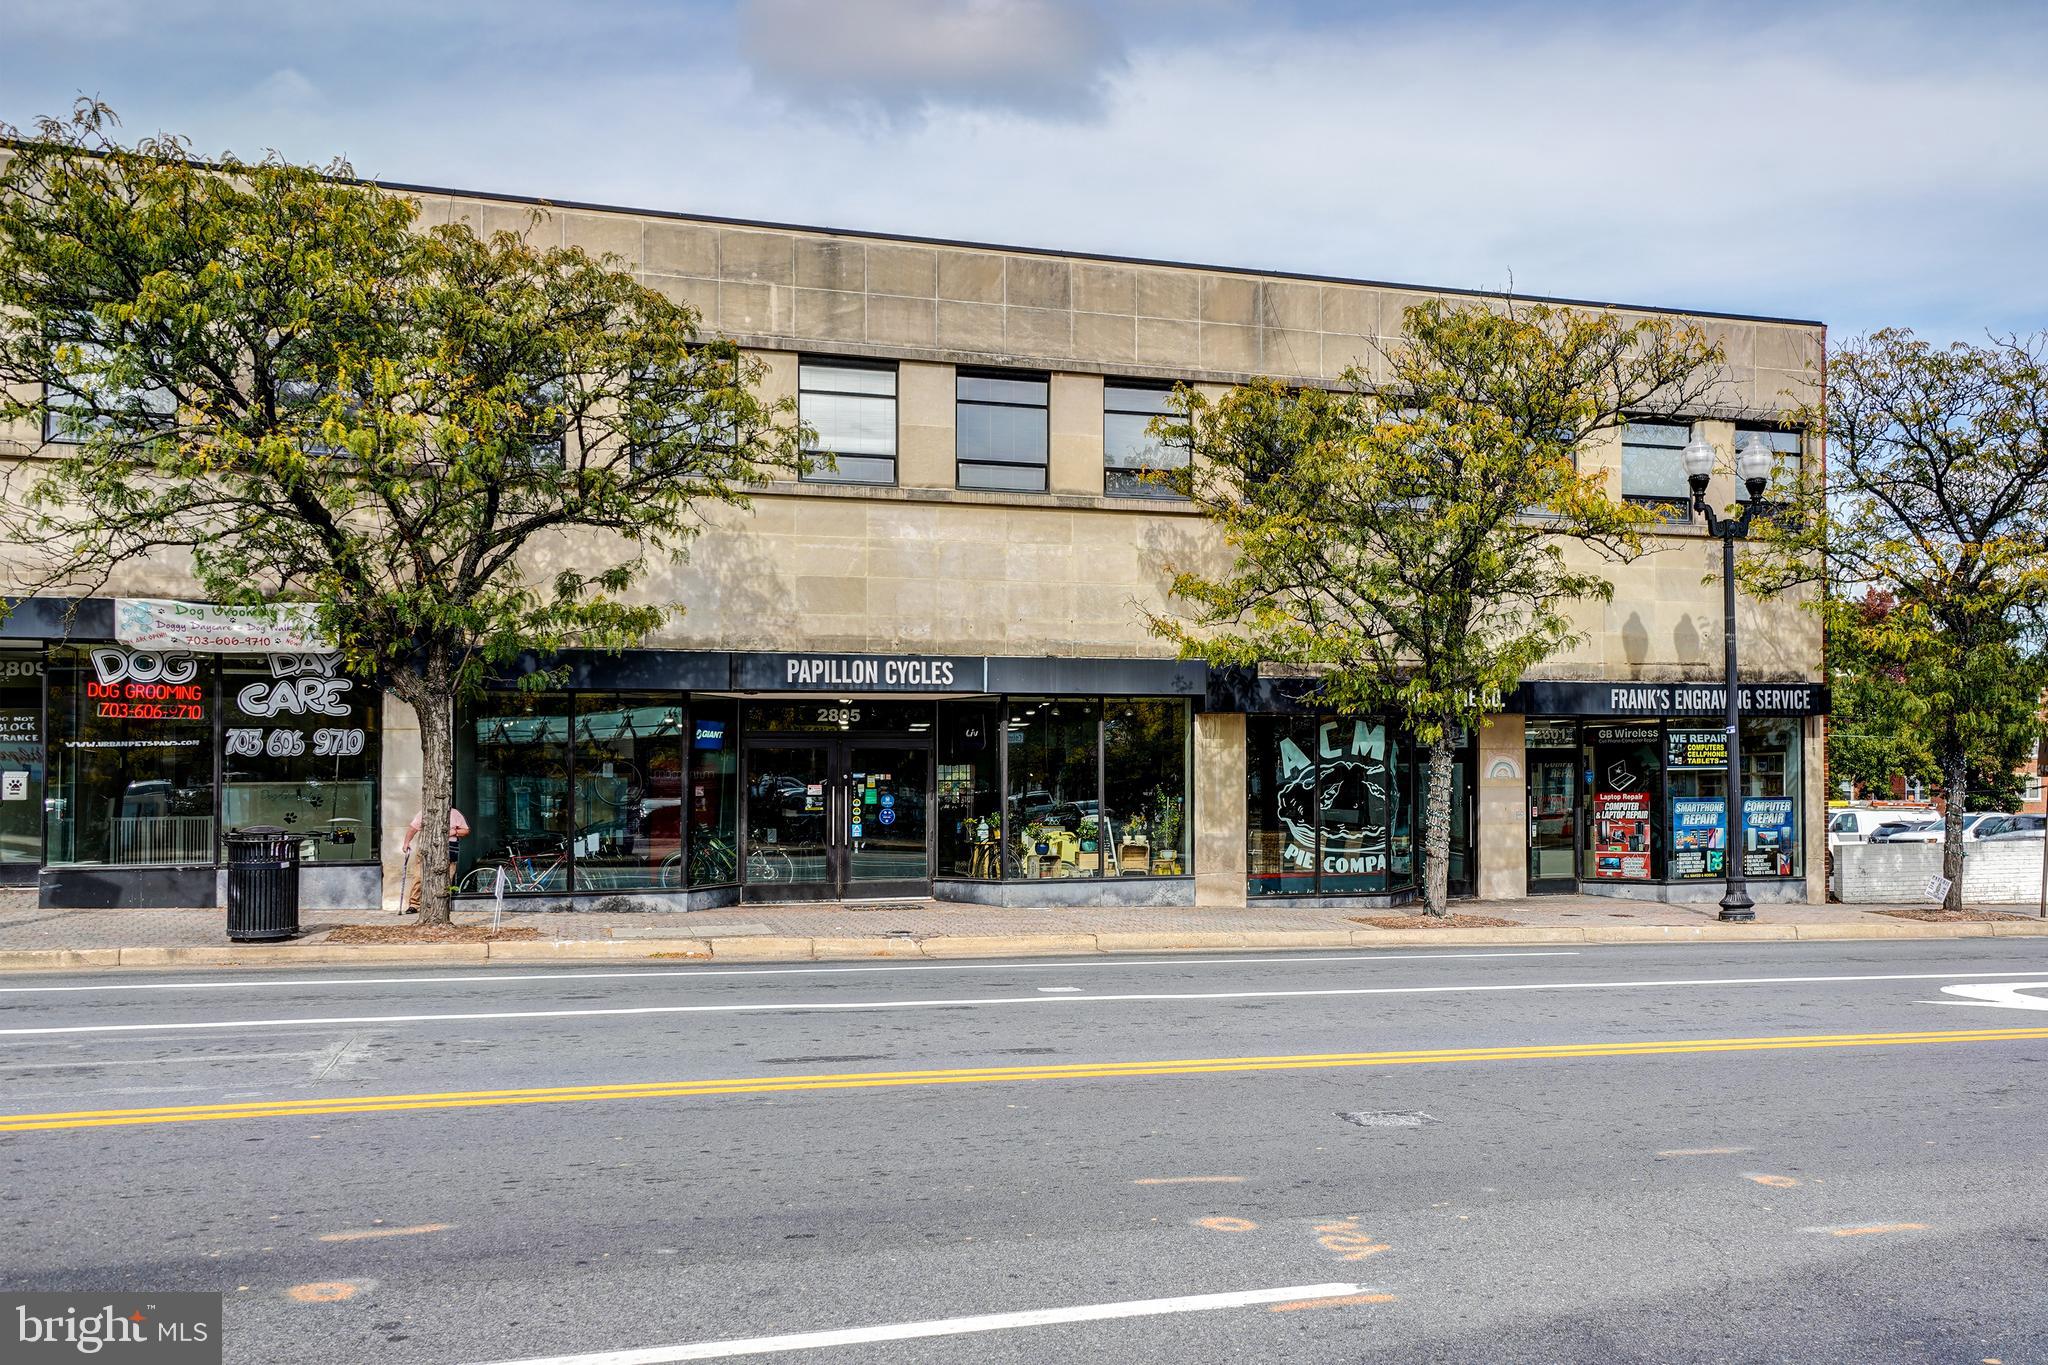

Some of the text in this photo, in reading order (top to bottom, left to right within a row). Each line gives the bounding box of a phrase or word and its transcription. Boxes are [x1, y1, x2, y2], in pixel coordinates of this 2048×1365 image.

[175, 602, 204, 620] Dog
[155, 620, 187, 632] Doggy
[191, 622, 233, 633] Daycare
[246, 622, 266, 634] Dog
[186, 636, 271, 647] 703-606-9710
[90, 648, 198, 686] DOG
[267, 652, 345, 678] DAY
[787, 659, 954, 685] PAPILLON CYCLES
[87, 682, 202, 700] DOG GROOMING
[238, 677, 353, 718] CARE
[1611, 688, 1811, 709] FRANK'S ENGRAVNG SERVICE
[101, 702, 201, 719] 703-606-9710
[817, 709, 861, 722] 2805
[702, 730, 724, 739] GIANT
[965, 729, 979, 737] Liv
[1598, 728, 1659, 739] GB Wireless
[1669, 734, 1728, 743] WE REPAIR
[225, 728, 365, 757] 703 606 9710
[1280, 720, 1399, 779] ACM
[1600, 793, 1644, 801] Laptop Repair
[1604, 802, 1640, 811] COMPUTER
[1675, 802, 1725, 813] SMARTPHONE
[1744, 801, 1792, 812] COMPUTER
[1601, 811, 1626, 819] LAPTOP
[1625, 810, 1649, 819] REPAIR
[1682, 814, 1718, 825] REPAIR
[1750, 813, 1785, 824] REPAIR
[1284, 843, 1315, 869] PIE
[1323, 853, 1386, 873] COMPA
